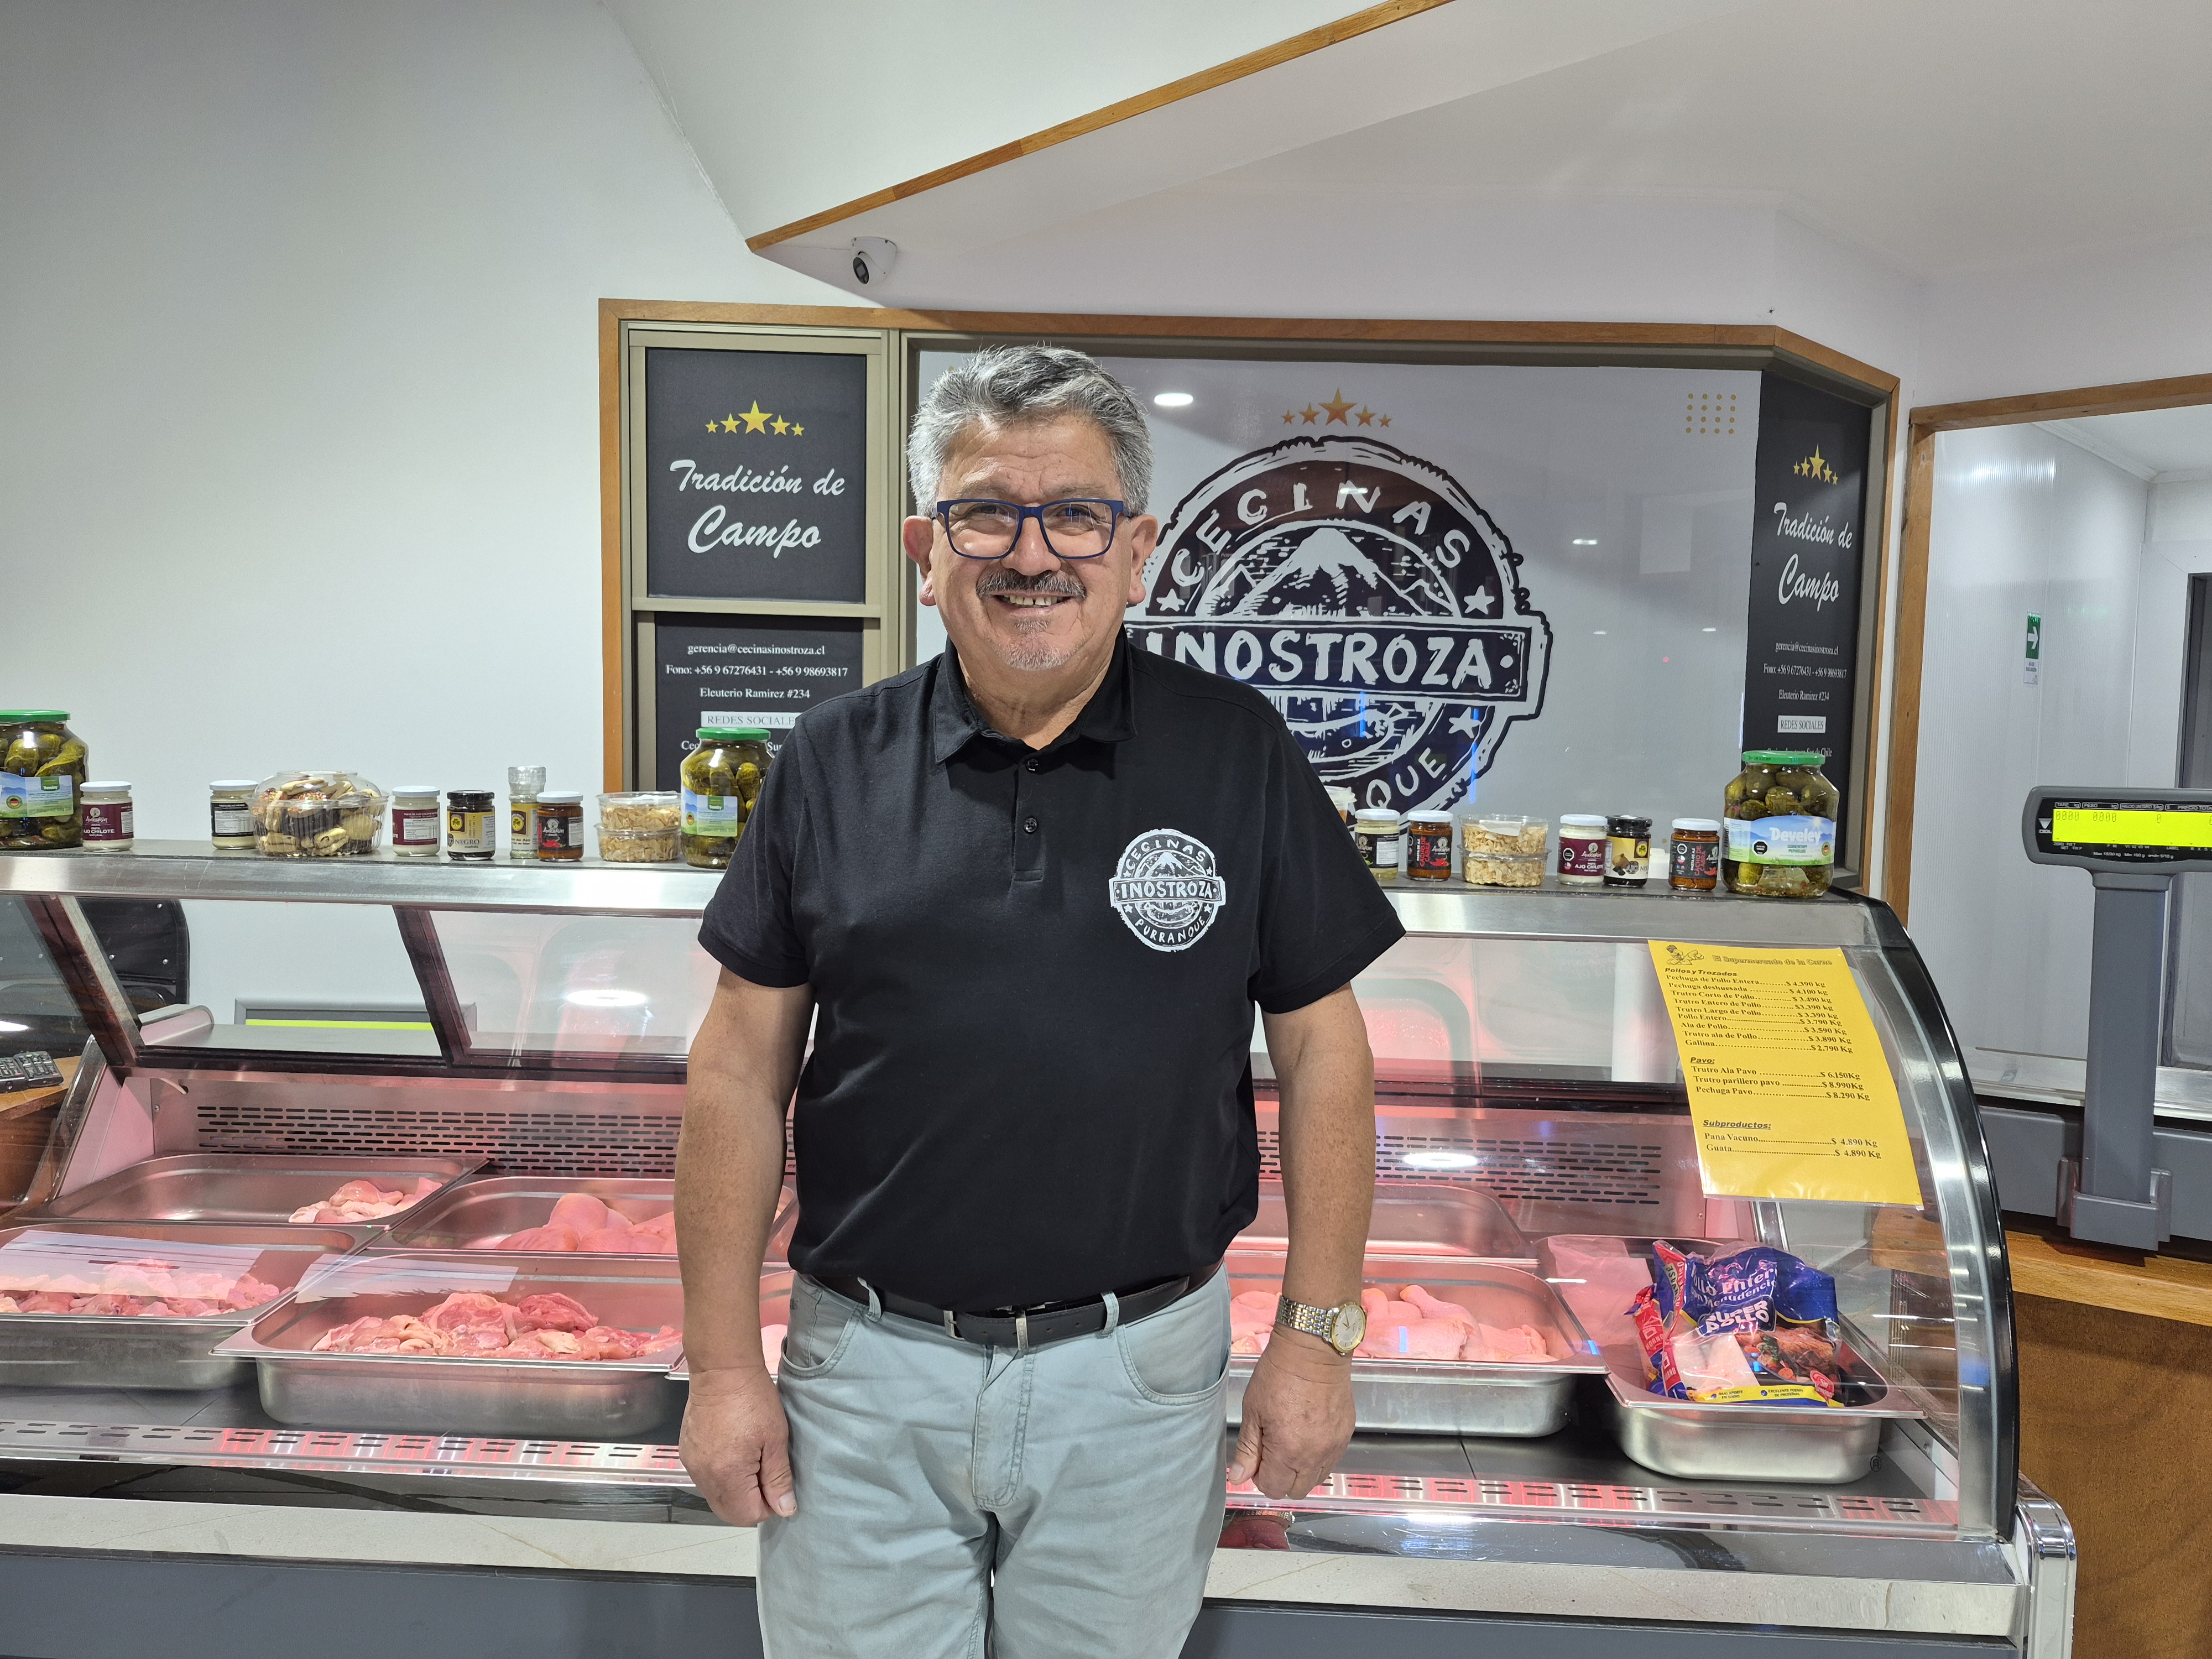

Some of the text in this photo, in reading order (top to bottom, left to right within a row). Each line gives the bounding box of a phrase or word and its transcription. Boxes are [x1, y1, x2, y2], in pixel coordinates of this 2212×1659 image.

[670, 460, 846, 496] Tradición de
[687, 504, 821, 559] Campo
[1773, 502, 1853, 549] Tradición de
[1170, 481, 1470, 587] CECINAS
[1778, 553, 1839, 612] Campo
[687, 643, 825, 655] gerencia@cecinasinostroza.cl
[1775, 640, 1839, 656] gerencia@cecinasinostroza.cl
[665, 664, 692, 675] Fono:
[694, 665, 713, 675] +56
[714, 665, 721, 675] 9
[722, 665, 766, 676] 67276431
[775, 666, 794, 676] +56
[795, 666, 802, 676] 9
[803, 667, 848, 677] 98693817
[1764, 663, 1777, 674] Fono:
[700, 687, 743, 697] Eleuterio
[786, 689, 810, 699] #234
[1778, 689, 1799, 700] Eleuterio
[1818, 691, 1829, 702] #234
[707, 715, 796, 726] REDES SOCIALE
[1780, 719, 1824, 731] REDES SOCIALES
[1769, 826, 1822, 845] Develey
[1125, 839, 1206, 870] CECINAS
[1695, 846, 1702, 854] DE
[1120, 880, 1213, 899] INOSTROZA
[1135, 915, 1205, 944] PURRANQUE
[1723, 956, 1783, 965] Supermercado
[1828, 1072, 1861, 1081] 6.150Kg
[1695, 1086, 1730, 1095] Pechuga
[1856, 1093, 1870, 1101] Kg
[1829, 1081, 1864, 1091] 8.990Kg
[1702, 1119, 1772, 1130] Subproductos:
[1726, 1134, 1759, 1142] Vacuno
[1864, 1139, 1878, 1148] Kg
[1706, 1144, 1732, 1152] Guata
[1867, 1150, 1881, 1160] Kg
[1666, 1266, 1679, 1297] NVASE
[1705, 1279, 1777, 1308] Menudenci
[1705, 1300, 1768, 1322] SUPER
[1705, 1310, 1770, 1333] POLLO
